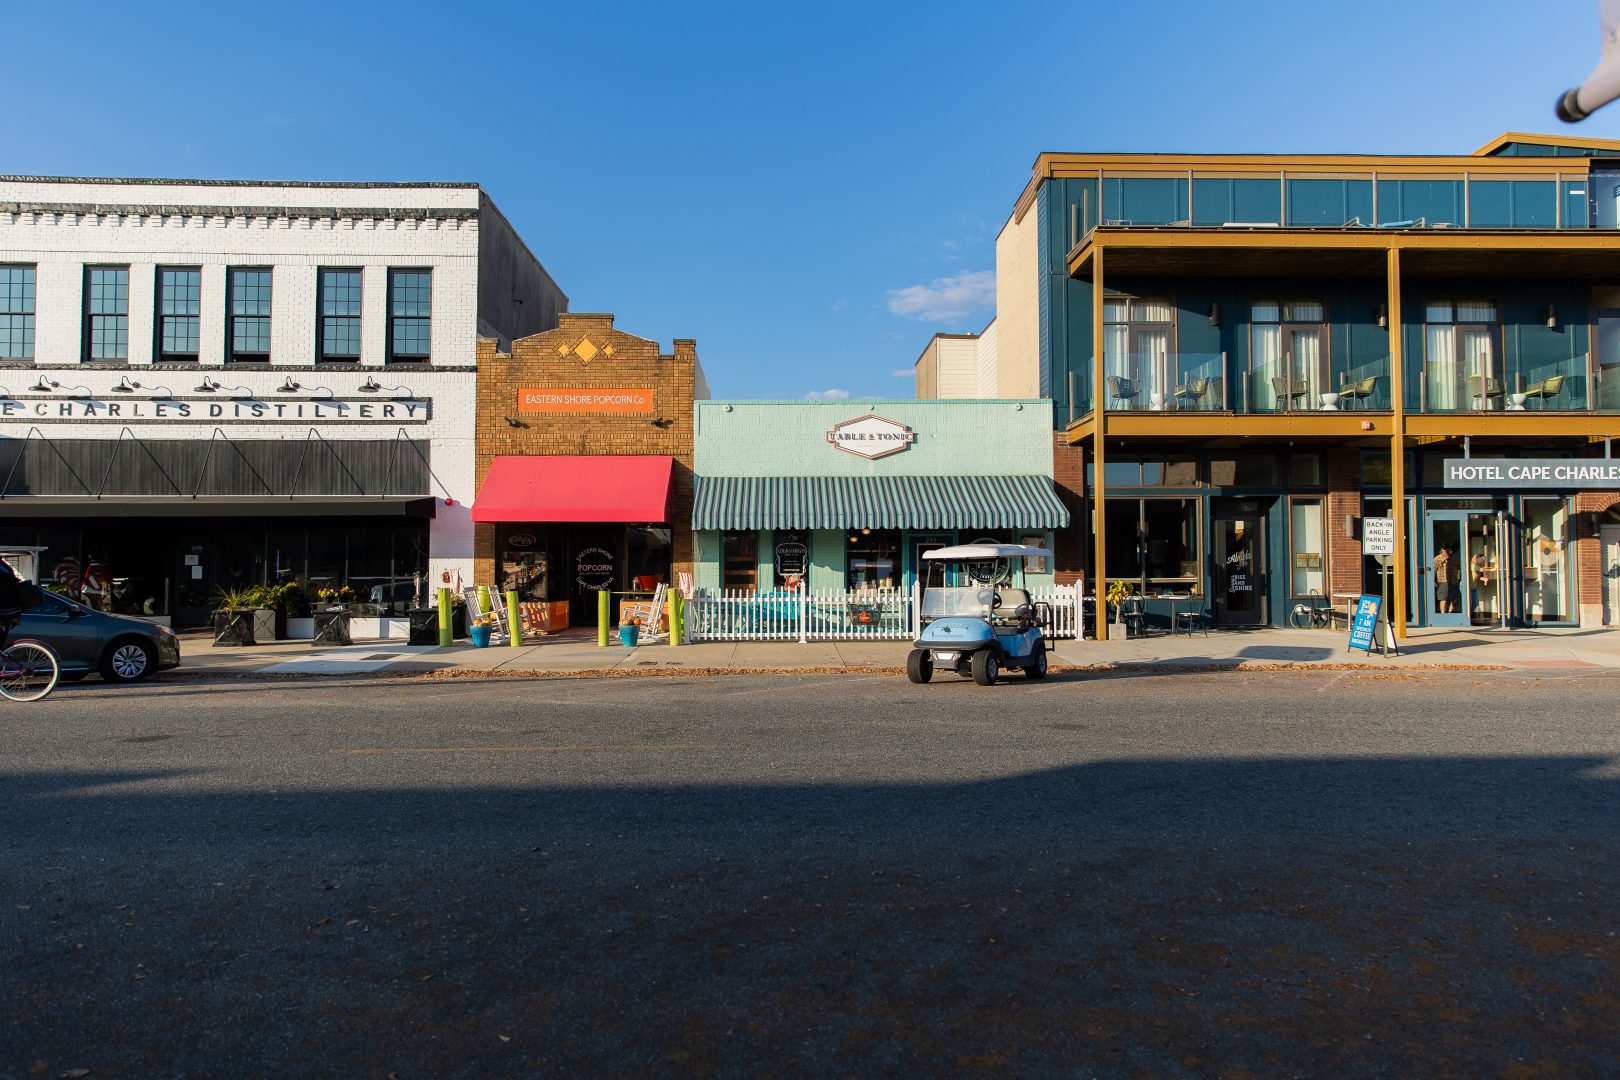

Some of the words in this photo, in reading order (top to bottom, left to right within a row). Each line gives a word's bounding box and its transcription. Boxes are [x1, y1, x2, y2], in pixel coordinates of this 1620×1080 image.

[525, 395, 563, 404] EASTERN
[564, 395, 592, 404] SHORE
[593, 395, 633, 404] POPCORN
[34, 402, 190, 417] CHARLES
[209, 403, 417, 417] DISTILLERY
[830, 433, 867, 441] TABLE
[876, 433, 914, 441] TONIC
[1450, 466, 1504, 480] HOTEL
[1507, 466, 1551, 480] CAPE
[1457, 501, 1474, 509] 235
[511, 535, 534, 545] OPEN
[577, 564, 613, 572] POPCORN
